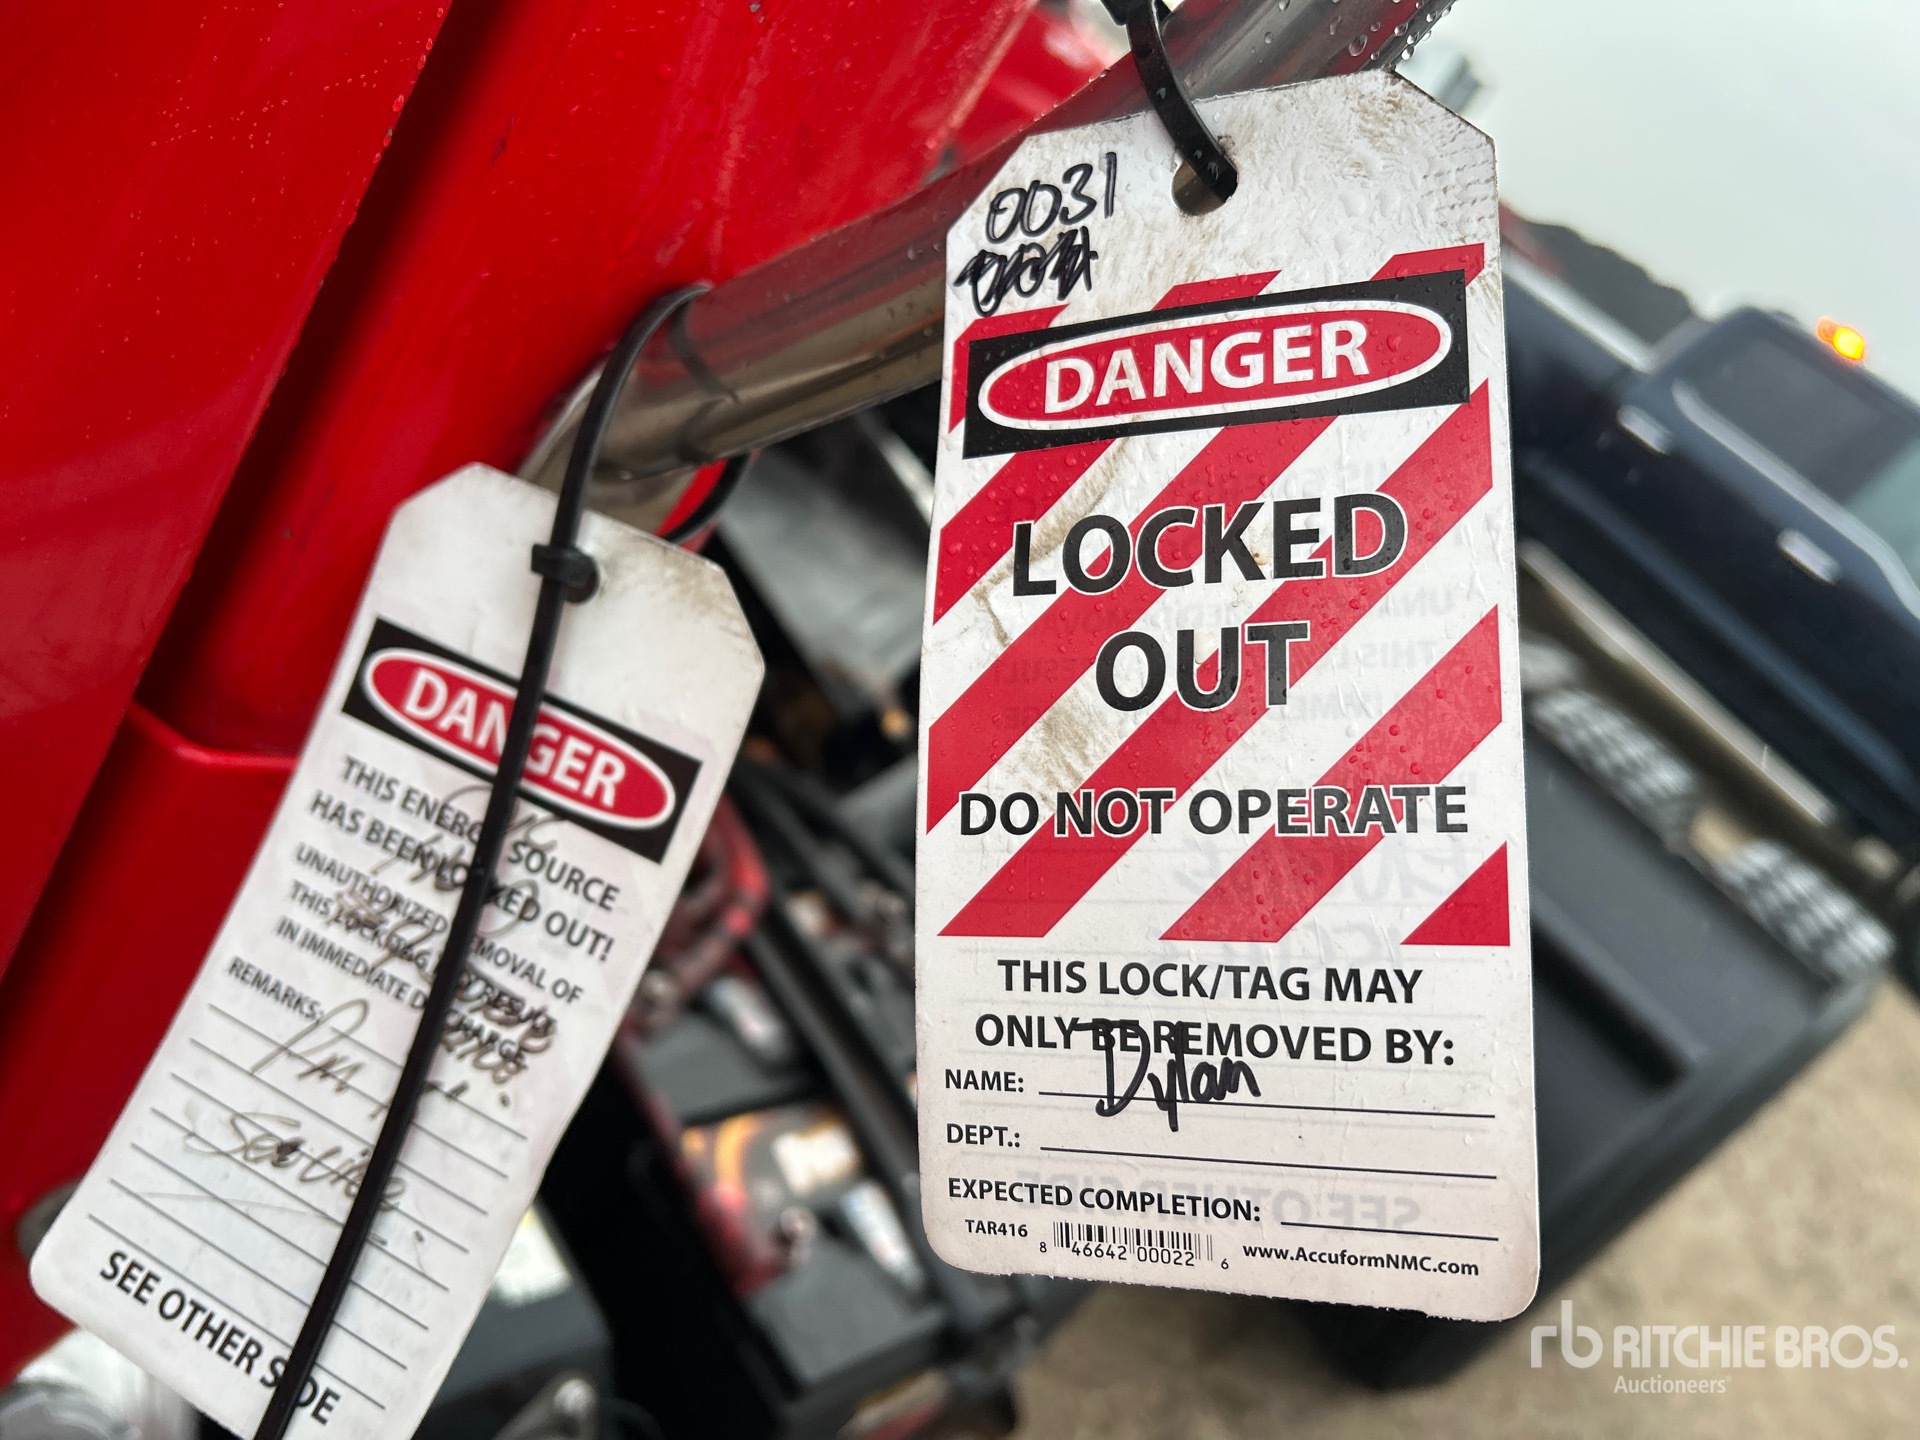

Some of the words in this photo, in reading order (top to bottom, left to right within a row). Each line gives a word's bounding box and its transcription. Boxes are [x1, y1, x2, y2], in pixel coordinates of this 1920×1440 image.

[985, 152, 1117, 244] 0031
[1044, 320, 1369, 414] DANGER
[1013, 494, 1407, 597] LOCKED
[1096, 622, 1309, 711] OUT
[340, 756, 400, 804] THIS
[399, 787, 487, 845] ENERG
[504, 837, 621, 913] SOURCE
[960, 792, 1039, 835] DO
[1055, 790, 1173, 835] NOT
[1189, 785, 1468, 835] OPERATE
[287, 880, 336, 919] THIS
[309, 790, 364, 835] HAS
[365, 819, 436, 872] BEEN
[540, 907, 615, 962] OUT!
[292, 843, 450, 936] UNAUTHORIZED
[549, 975, 585, 1008] OF
[227, 956, 327, 1024] REMARKS:
[275, 917, 301, 943] IN
[298, 929, 410, 1003] IMMEDIATE
[998, 959, 1087, 993] THIS
[1100, 962, 1309, 1000] LOCK/TAG
[1325, 968, 1423, 1004] MAY
[975, 1013, 1079, 1049] ONLY
[1092, 1018, 1140, 1052] BE
[1153, 1020, 1371, 1063] REMOVED
[1386, 1028, 1455, 1066] BY:
[945, 1068, 1024, 1094] NAME:
[1074, 1018, 1261, 1132] Dylan
[946, 1123, 1021, 1149] DEPT.:
[949, 1177, 1073, 1206] EXPECTED
[1079, 1187, 1260, 1222] COMPLETION:
[965, 1219, 1028, 1238] TAR416
[1039, 1241, 1047, 1253] 8
[1071, 1241, 1127, 1260] 46642
[1137, 1246, 1195, 1267] 00022
[1220, 1257, 1229, 1270] 6
[1243, 1242, 1479, 1277] www.AccuformNMC.com
[100, 1250, 161, 1305] SEE
[158, 1288, 264, 1376] OTHER
[260, 1355, 341, 1425] SDE
